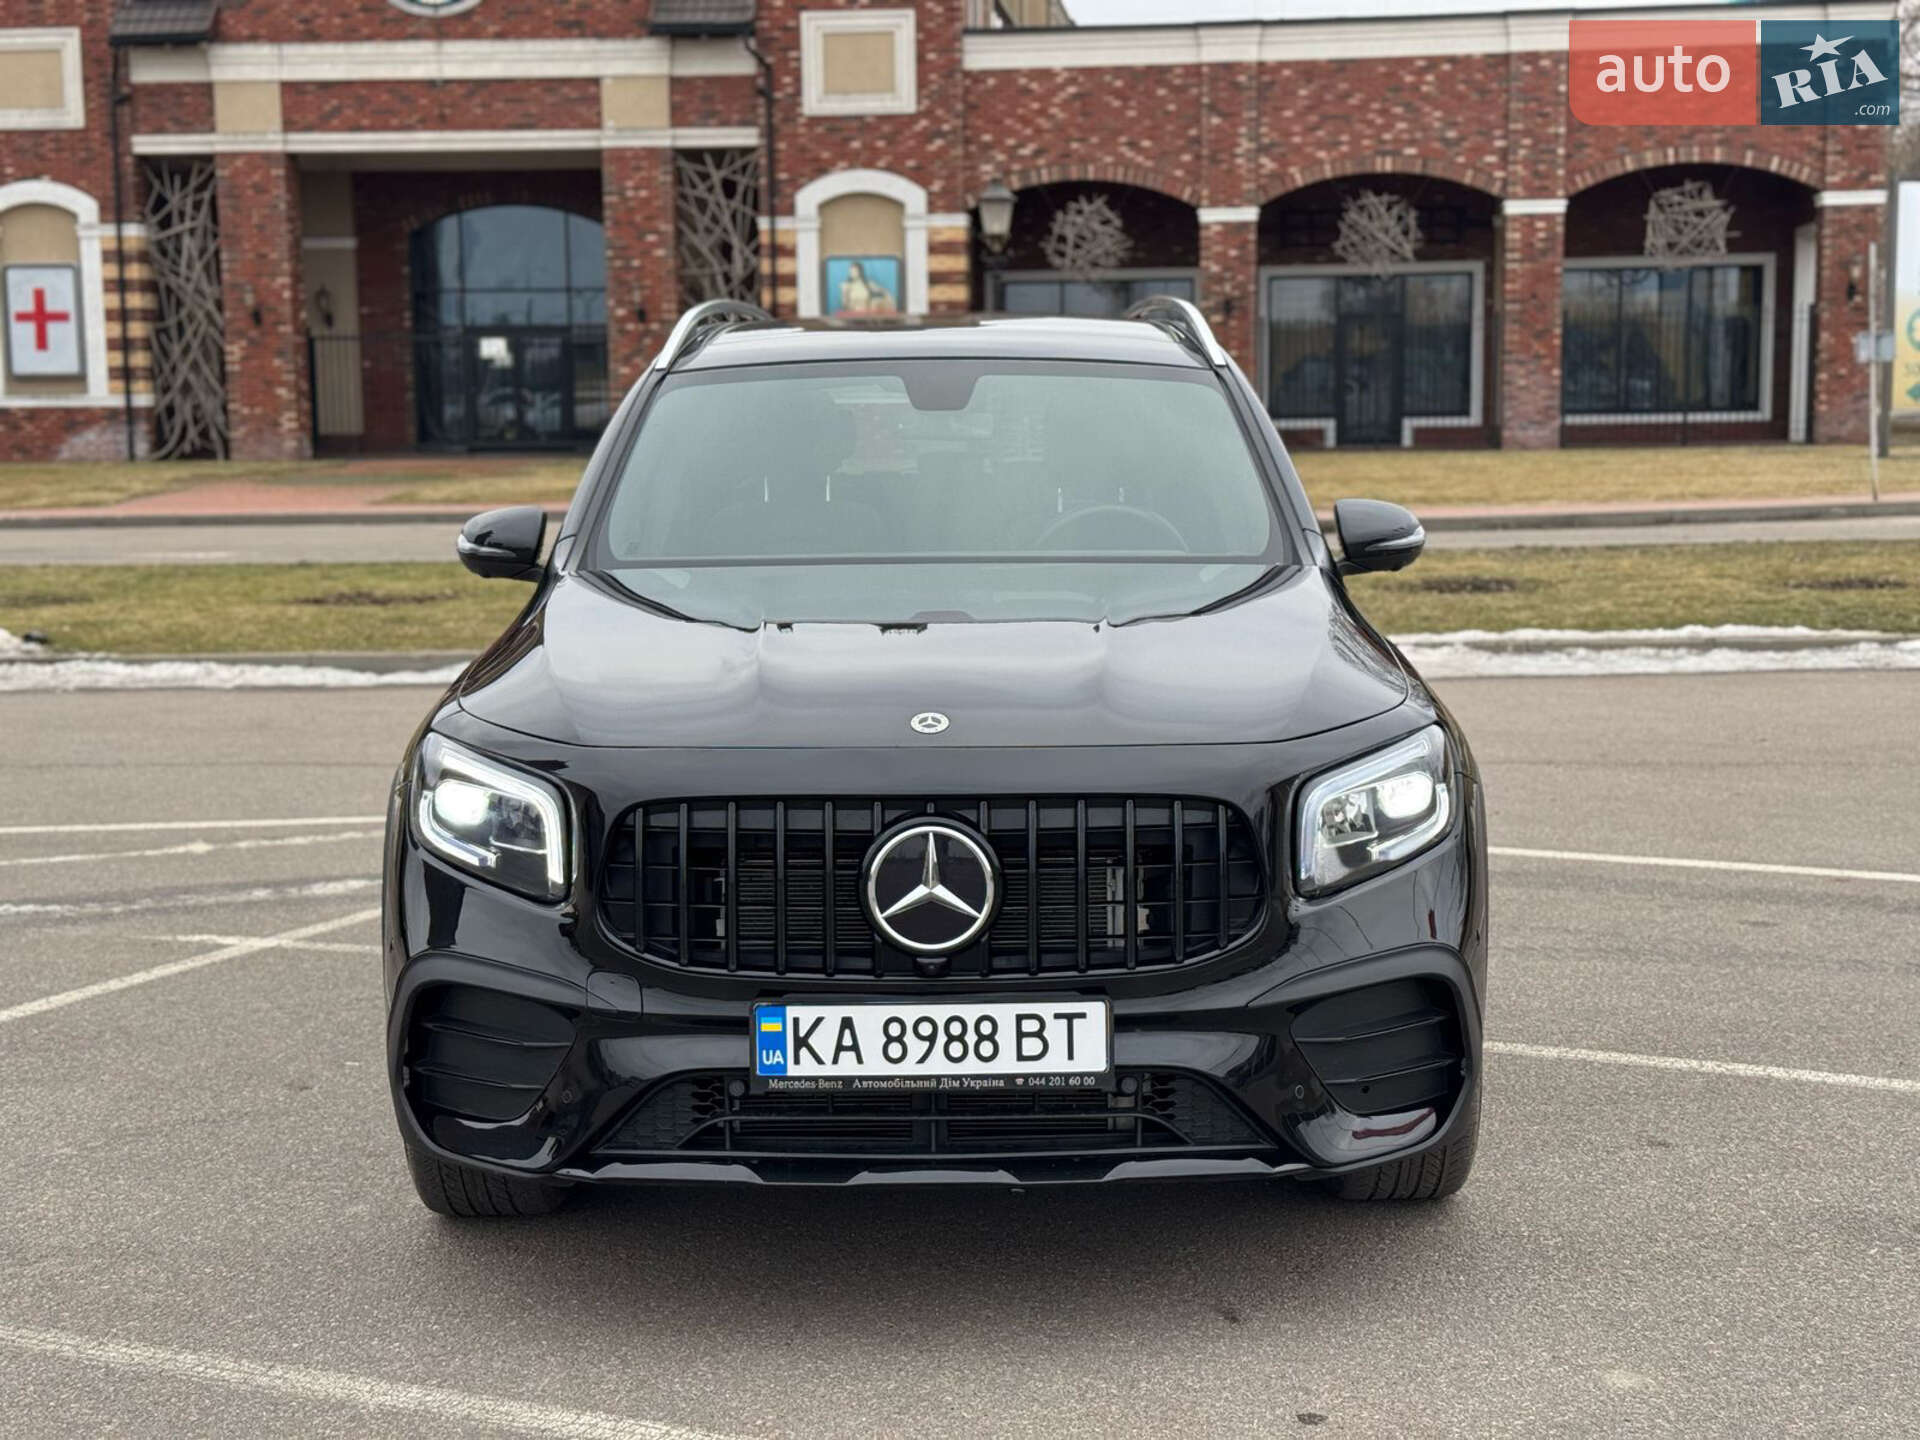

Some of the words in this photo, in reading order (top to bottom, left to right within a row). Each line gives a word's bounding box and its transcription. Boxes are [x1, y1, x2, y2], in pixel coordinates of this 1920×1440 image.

[792, 1016, 864, 1066] KA
[881, 1014, 1000, 1065] 8988
[1015, 1012, 1087, 1063] BT
[762, 1049, 785, 1066] UA
[768, 1078, 844, 1090] Mercedes-Benz
[852, 1077, 937, 1089] Автомобільний
[939, 1077, 960, 1089] Дім
[962, 1077, 1005, 1089] Україна
[1028, 1076, 1046, 1087] 044
[1049, 1076, 1065, 1087] 201
[1068, 1076, 1081, 1086] 60
[1083, 1075, 1096, 1086] 00
